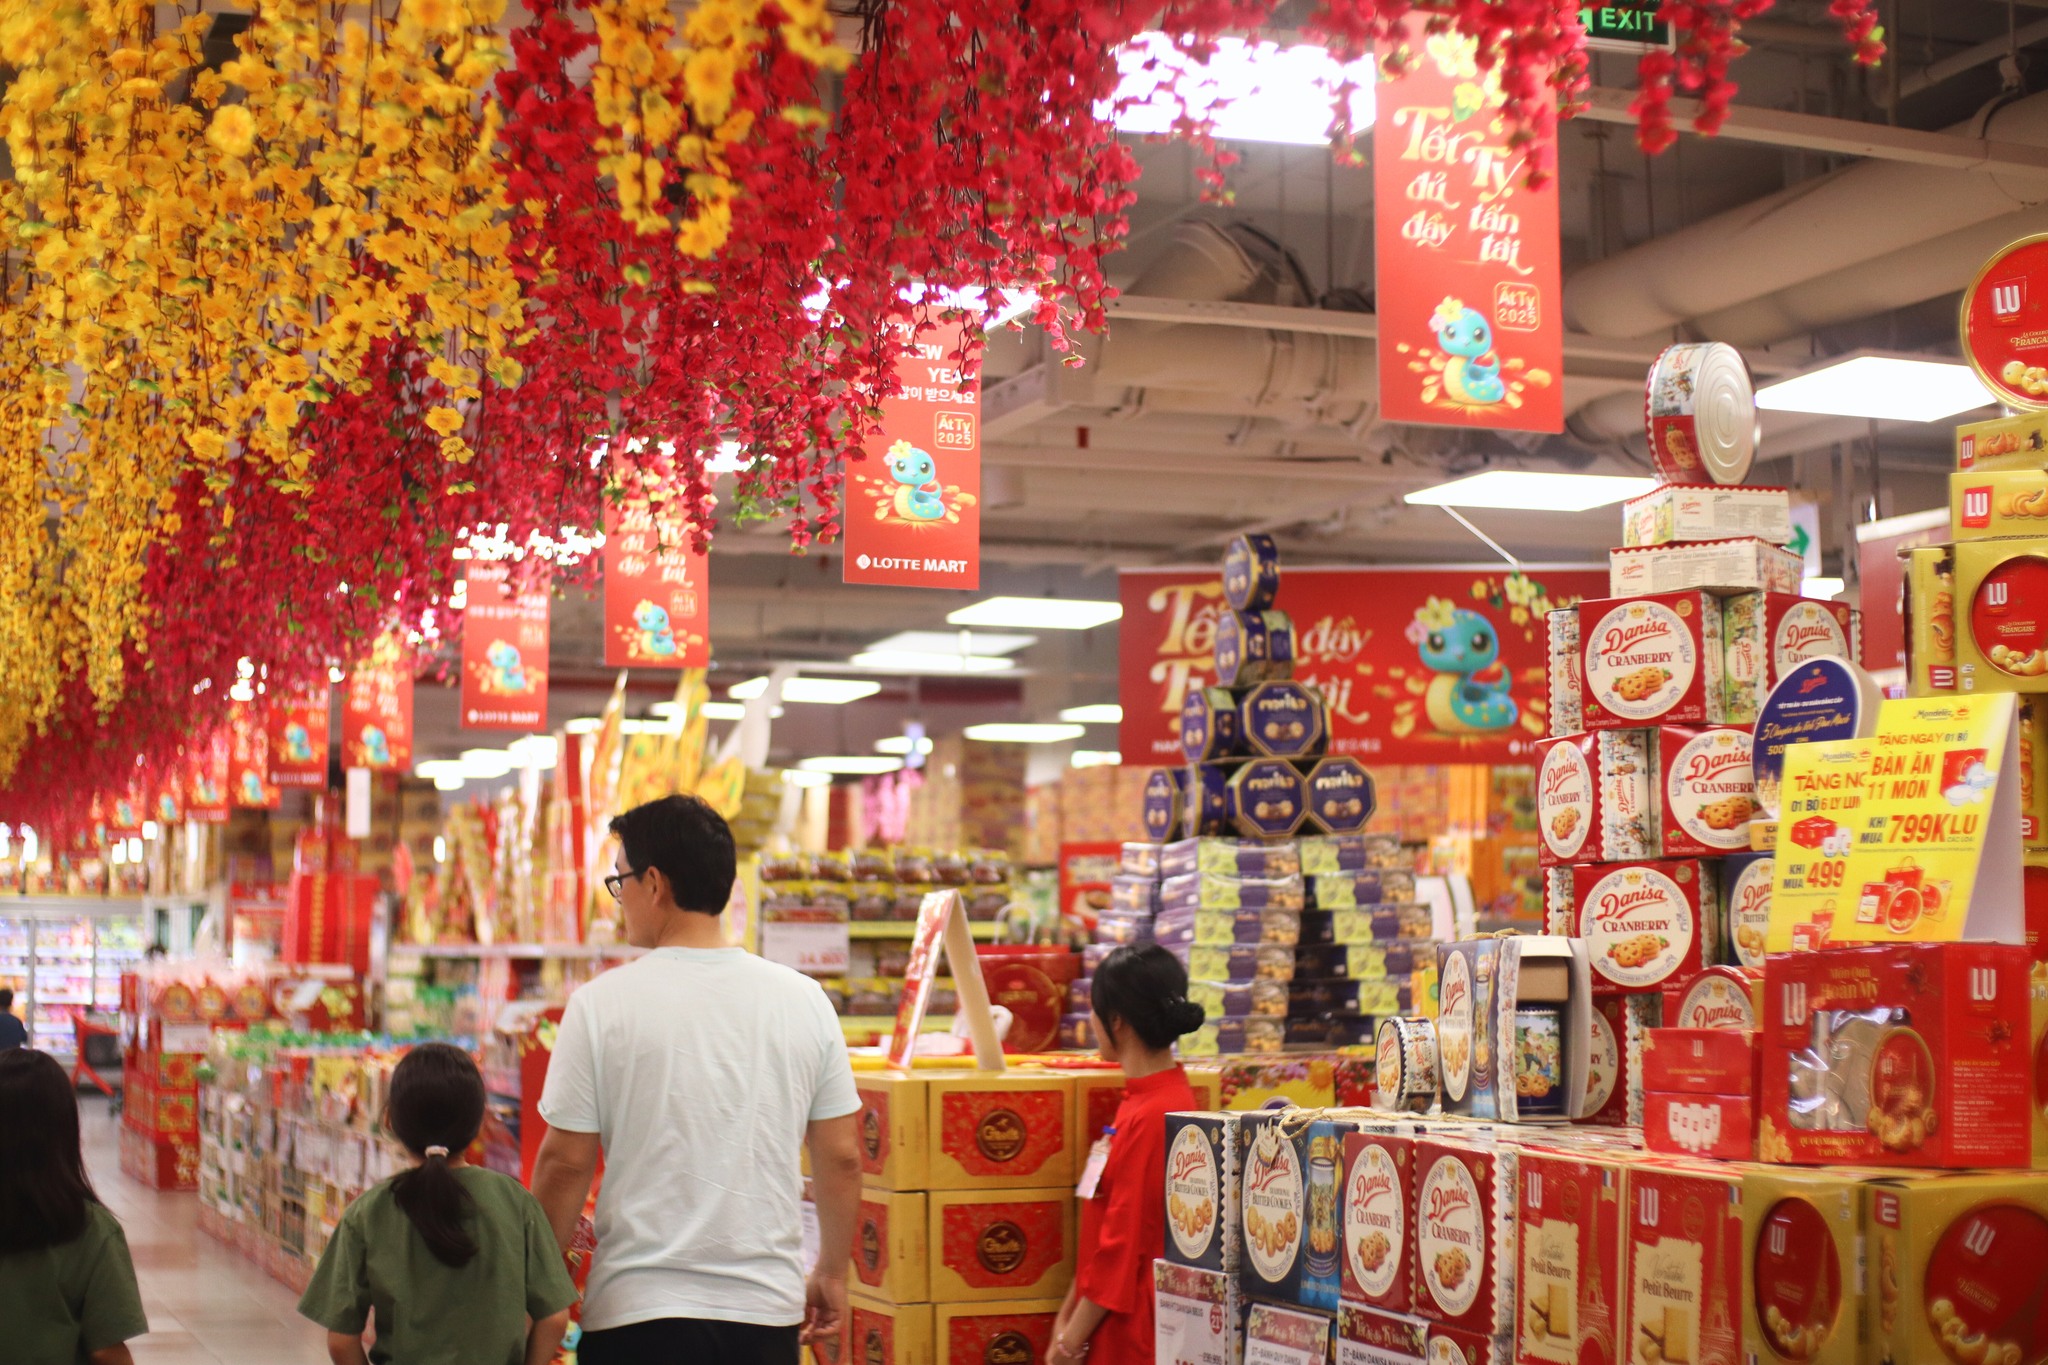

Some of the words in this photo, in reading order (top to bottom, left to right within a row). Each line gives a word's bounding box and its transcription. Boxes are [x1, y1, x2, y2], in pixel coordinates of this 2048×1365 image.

[1601, 7, 1657, 32] EXIT
[1393, 106, 1485, 165] Tết
[1406, 171, 1460, 209] đủ
[1401, 210, 1457, 247] đầy
[1469, 203, 1520, 234] tấn
[1479, 233, 1534, 275] tài
[1994, 285, 2021, 315] LU
[1498, 308, 1537, 324] 2025
[938, 432, 972, 445] 2025
[1962, 441, 1973, 459] LU
[1966, 492, 1988, 517] LU
[872, 557, 921, 570] LOTTE
[923, 557, 968, 573] MART
[1988, 582, 2008, 606] LU
[1601, 617, 1671, 656] Danisa
[1783, 620, 1833, 651] Danisa
[1607, 651, 1674, 668] CRANBERRY
[1933, 669, 1955, 687] LU
[1546, 758, 1580, 795] Danisa
[1871, 751, 1907, 776] BÀN
[1910, 751, 1936, 775] ĂN
[1691, 781, 1755, 794] CRANBERR
[1794, 769, 1841, 797] TẶNG
[1869, 781, 1886, 800] 11
[1890, 775, 1930, 800] MÓN
[1548, 791, 1581, 807] CRANBERRY
[1791, 800, 1801, 813] 01
[1820, 797, 1828, 811] 6
[1830, 797, 1840, 810] LY
[1868, 816, 1888, 828] KHI
[1950, 814, 1979, 835] LU
[1859, 832, 1883, 844] MUA
[1783, 879, 1804, 889] MUA
[1789, 864, 1805, 875] KHI
[1806, 860, 1847, 888] 499
[1596, 884, 1668, 921] Danisa
[1602, 919, 1671, 933] CRANBERRY
[1972, 967, 1997, 1001] LU
[1693, 999, 1745, 1028] Danisa
[1782, 982, 1807, 1026] LU
[1173, 1145, 1207, 1180] Danisa
[1353, 1168, 1391, 1208] Danisa
[1527, 1171, 1542, 1209] LU
[1428, 1181, 1471, 1222] Danisa
[1639, 1186, 1659, 1227] LU
[1881, 1197, 1897, 1223] LU
[1356, 1208, 1391, 1229] CRANBERRY
[1431, 1222, 1472, 1245] CRANBERRY
[1771, 1224, 1786, 1256] LU
[1964, 1219, 1996, 1256] LU
[1530, 1257, 1546, 1275] Petit
[1546, 1260, 1572, 1281] Beurre
[1642, 1278, 1663, 1297] Petit
[1663, 1281, 1694, 1304] Beurre
